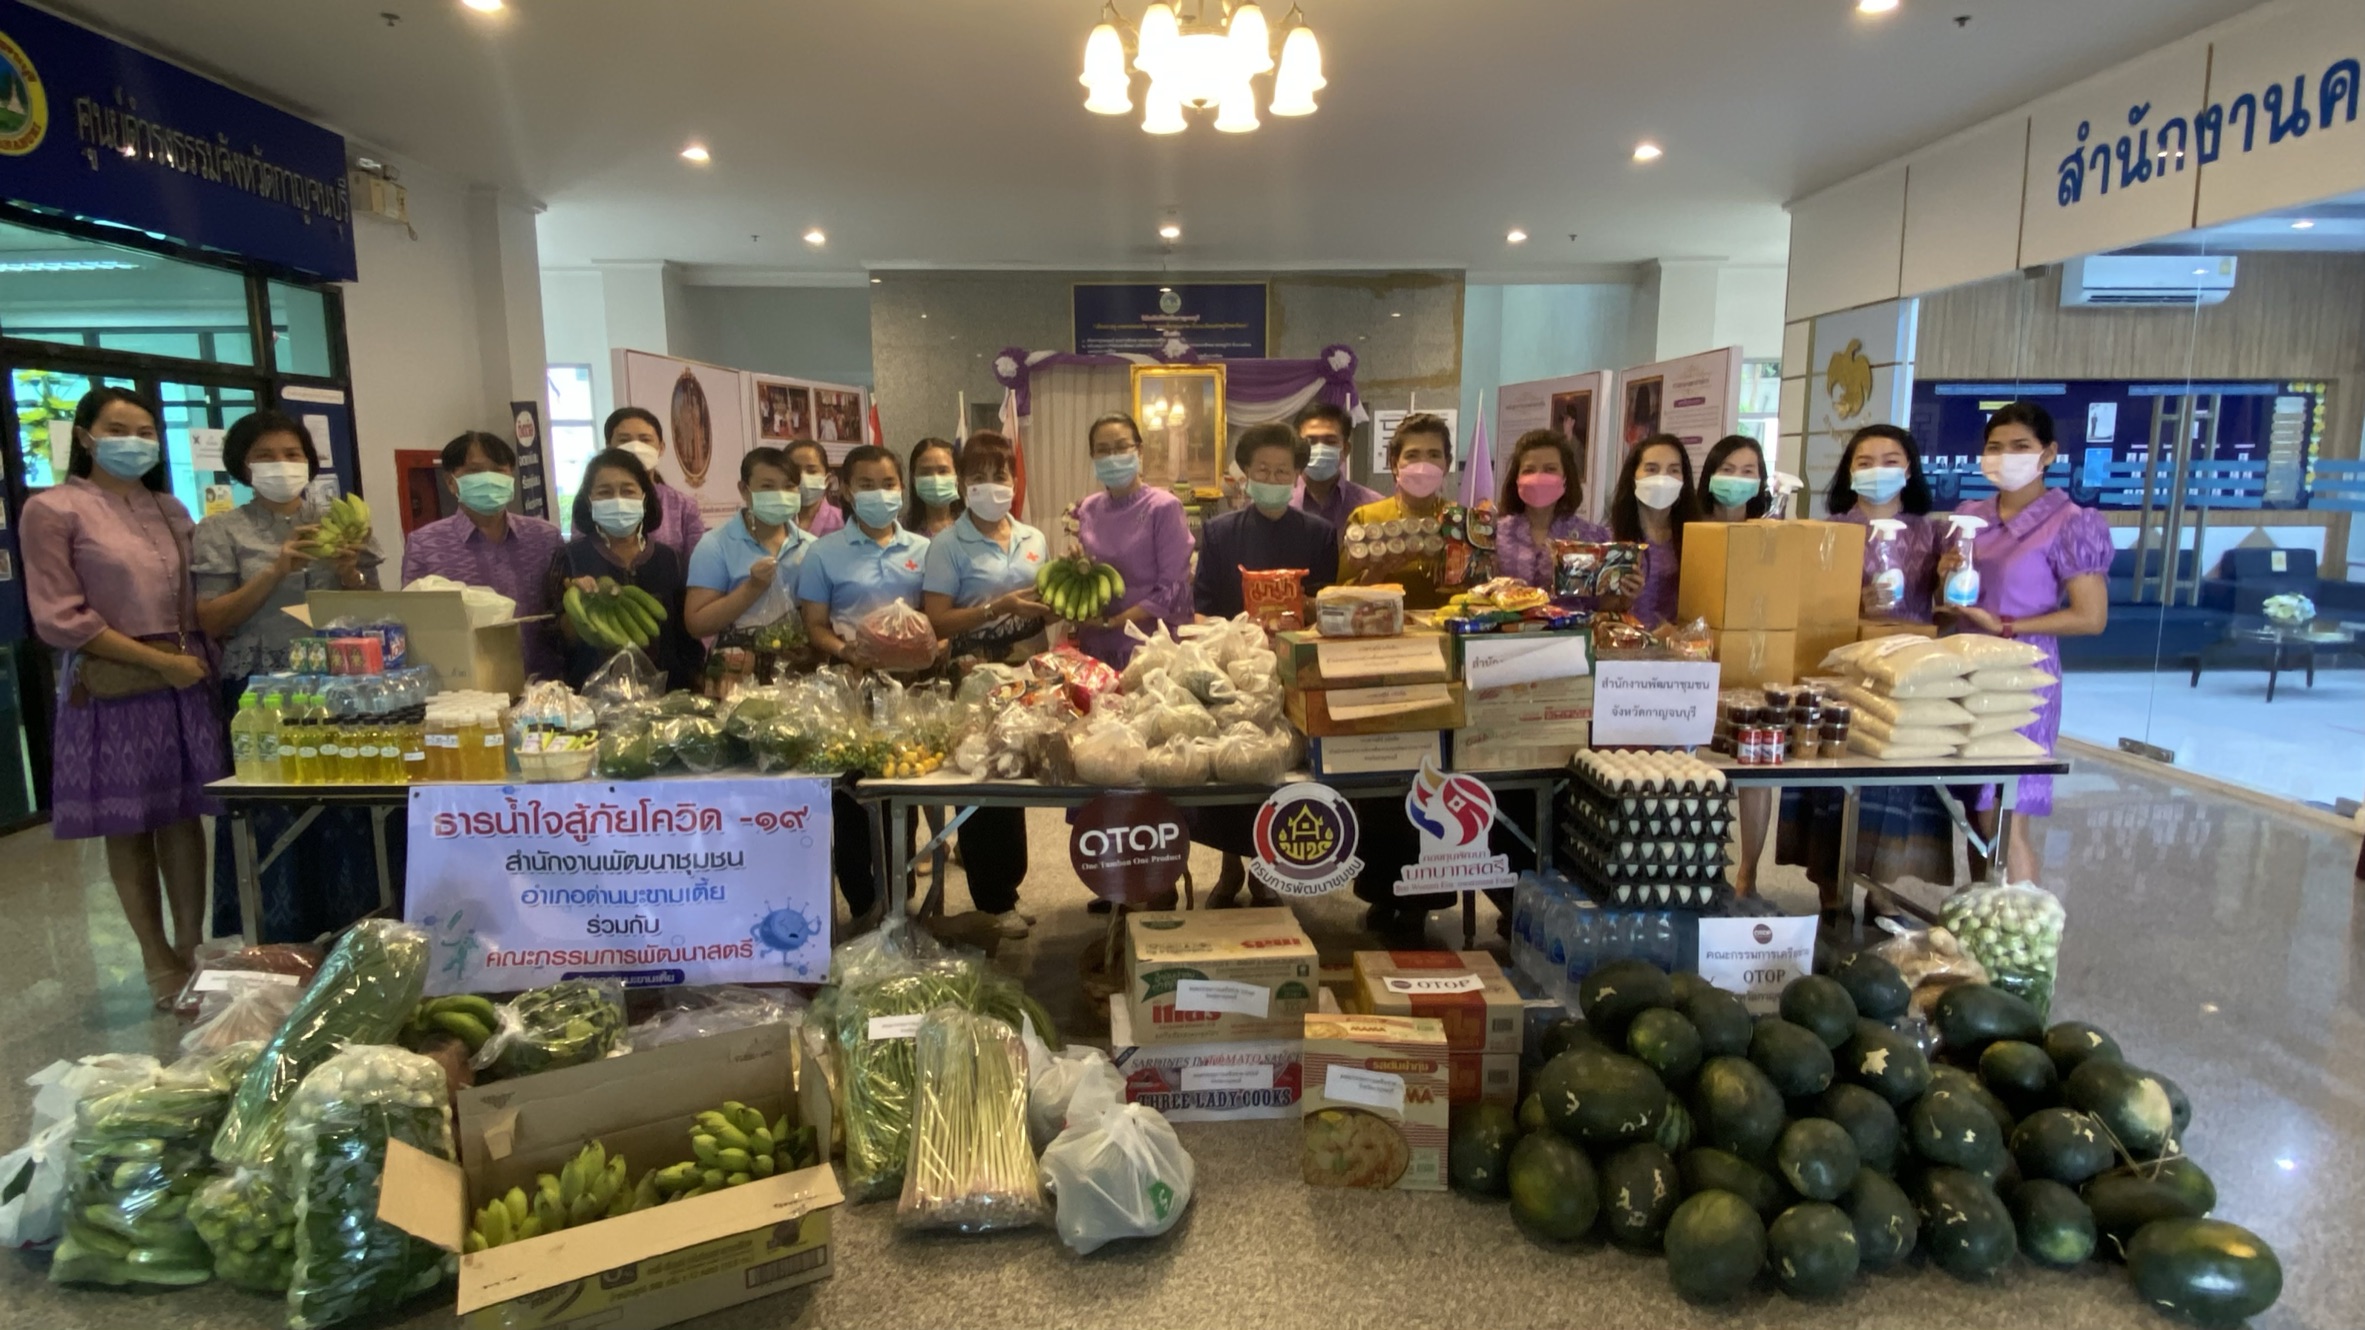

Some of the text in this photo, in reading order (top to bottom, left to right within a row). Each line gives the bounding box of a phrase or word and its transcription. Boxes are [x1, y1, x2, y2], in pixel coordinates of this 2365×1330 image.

[1601, 677, 1709, 693] สำนักงานพัฒนาชุมชน
[1612, 704, 1696, 721] จังหวัดกาญจนบุรี
[434, 798, 722, 842] ธารน้ำใจสู้ภัยโควิด
[1079, 823, 1179, 856] OTOP
[505, 849, 745, 876] สำนักงานพัฒนาชุมชน
[1101, 860, 1131, 869] Tambon
[1133, 857, 1149, 865] One
[1151, 854, 1181, 863] Product
[1406, 860, 1504, 880] บทบาทสตรี
[1251, 859, 1362, 895] กรมการพัฒนาชุมชน
[521, 878, 726, 905] อำเภอด่านมะขามเตี้ย
[586, 914, 661, 934] ร่วมกับ
[486, 938, 754, 967] คณะกรรมการพัฒนาสตรี
[1417, 979, 1470, 989] OTOP
[1743, 968, 1786, 983] OTOP
[1131, 1056, 1189, 1068] SARDINES
[1206, 1053, 1262, 1066] TOMATO
[1138, 1088, 1291, 1110] THREE LADY COOKS
